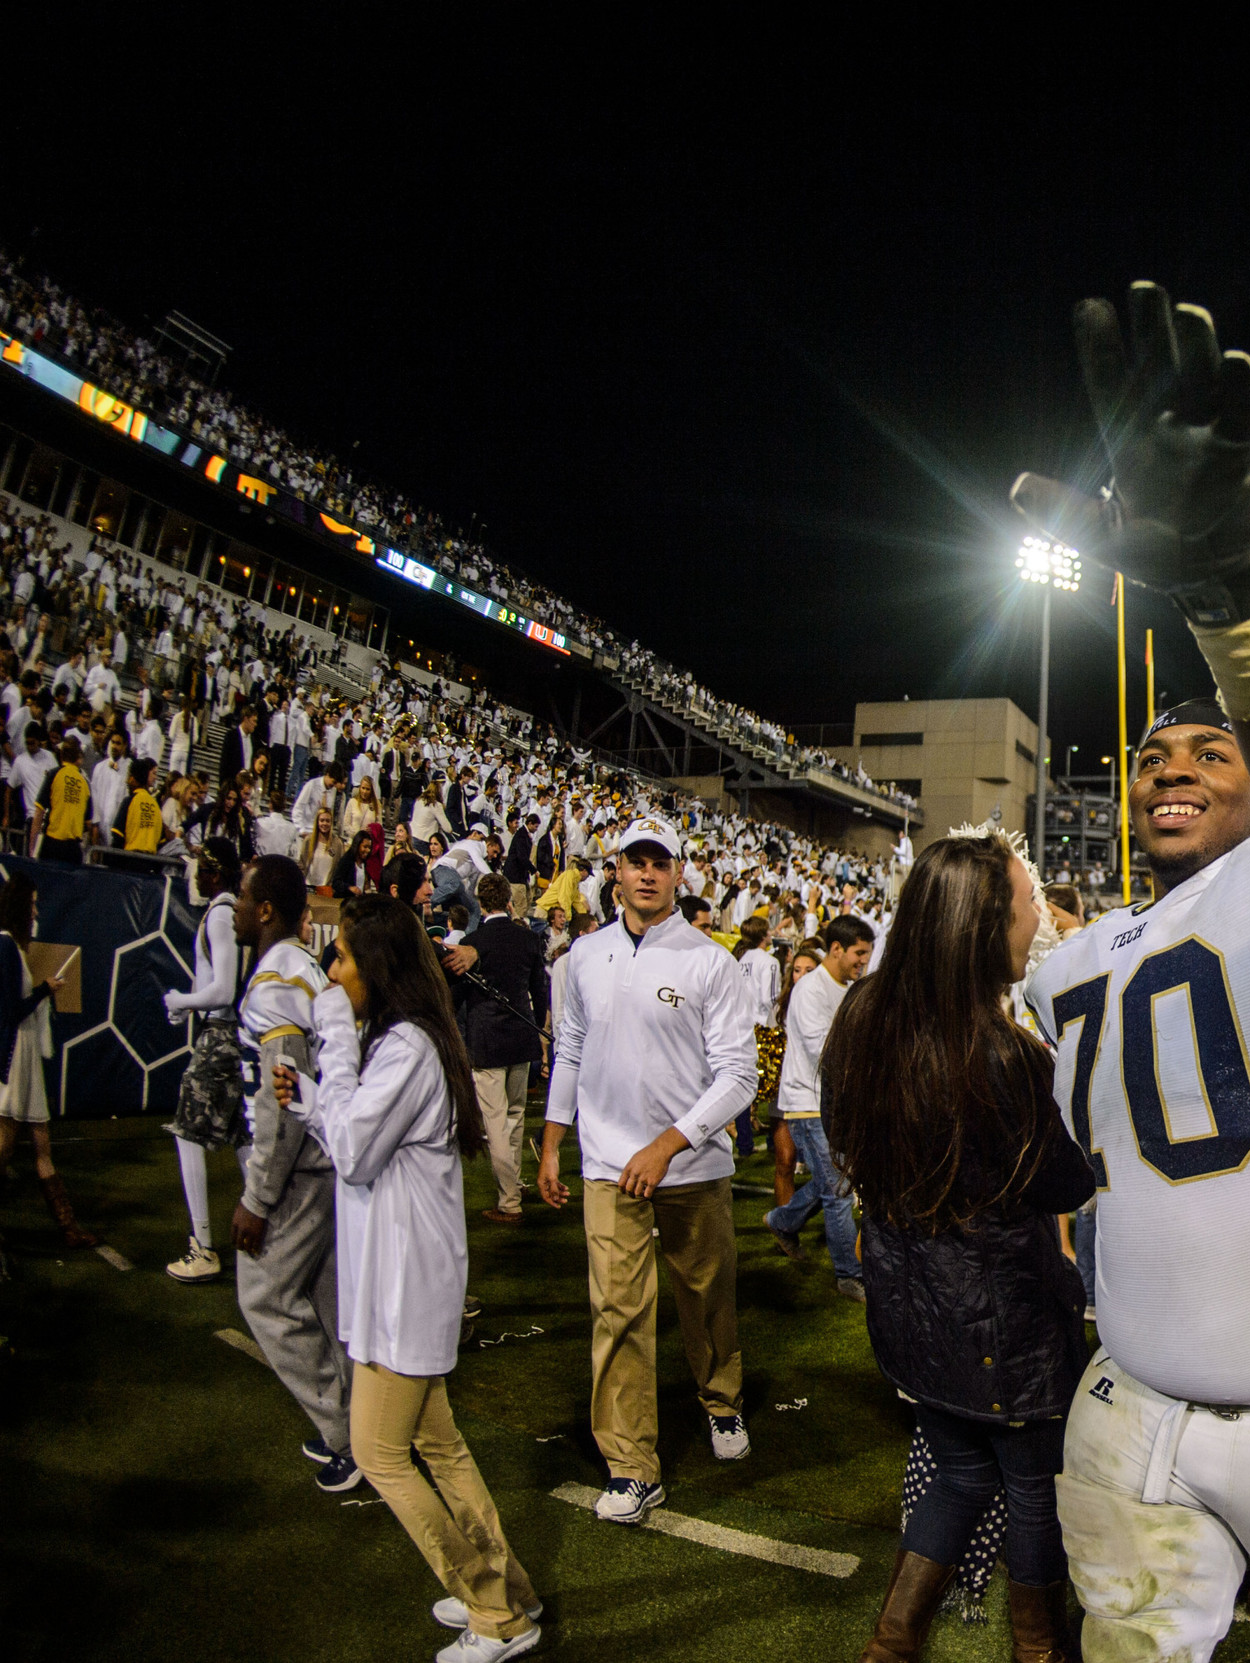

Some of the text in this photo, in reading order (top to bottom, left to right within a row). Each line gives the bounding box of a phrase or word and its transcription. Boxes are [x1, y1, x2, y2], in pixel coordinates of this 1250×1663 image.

[387, 549, 404, 569] 100
[553, 632, 565, 648] 100
[64, 775, 82, 789] CSC
[140, 802, 155, 812] CSC
[638, 819, 666, 835] GT
[1111, 922, 1148, 951] TECH
[657, 986, 686, 1009] GT
